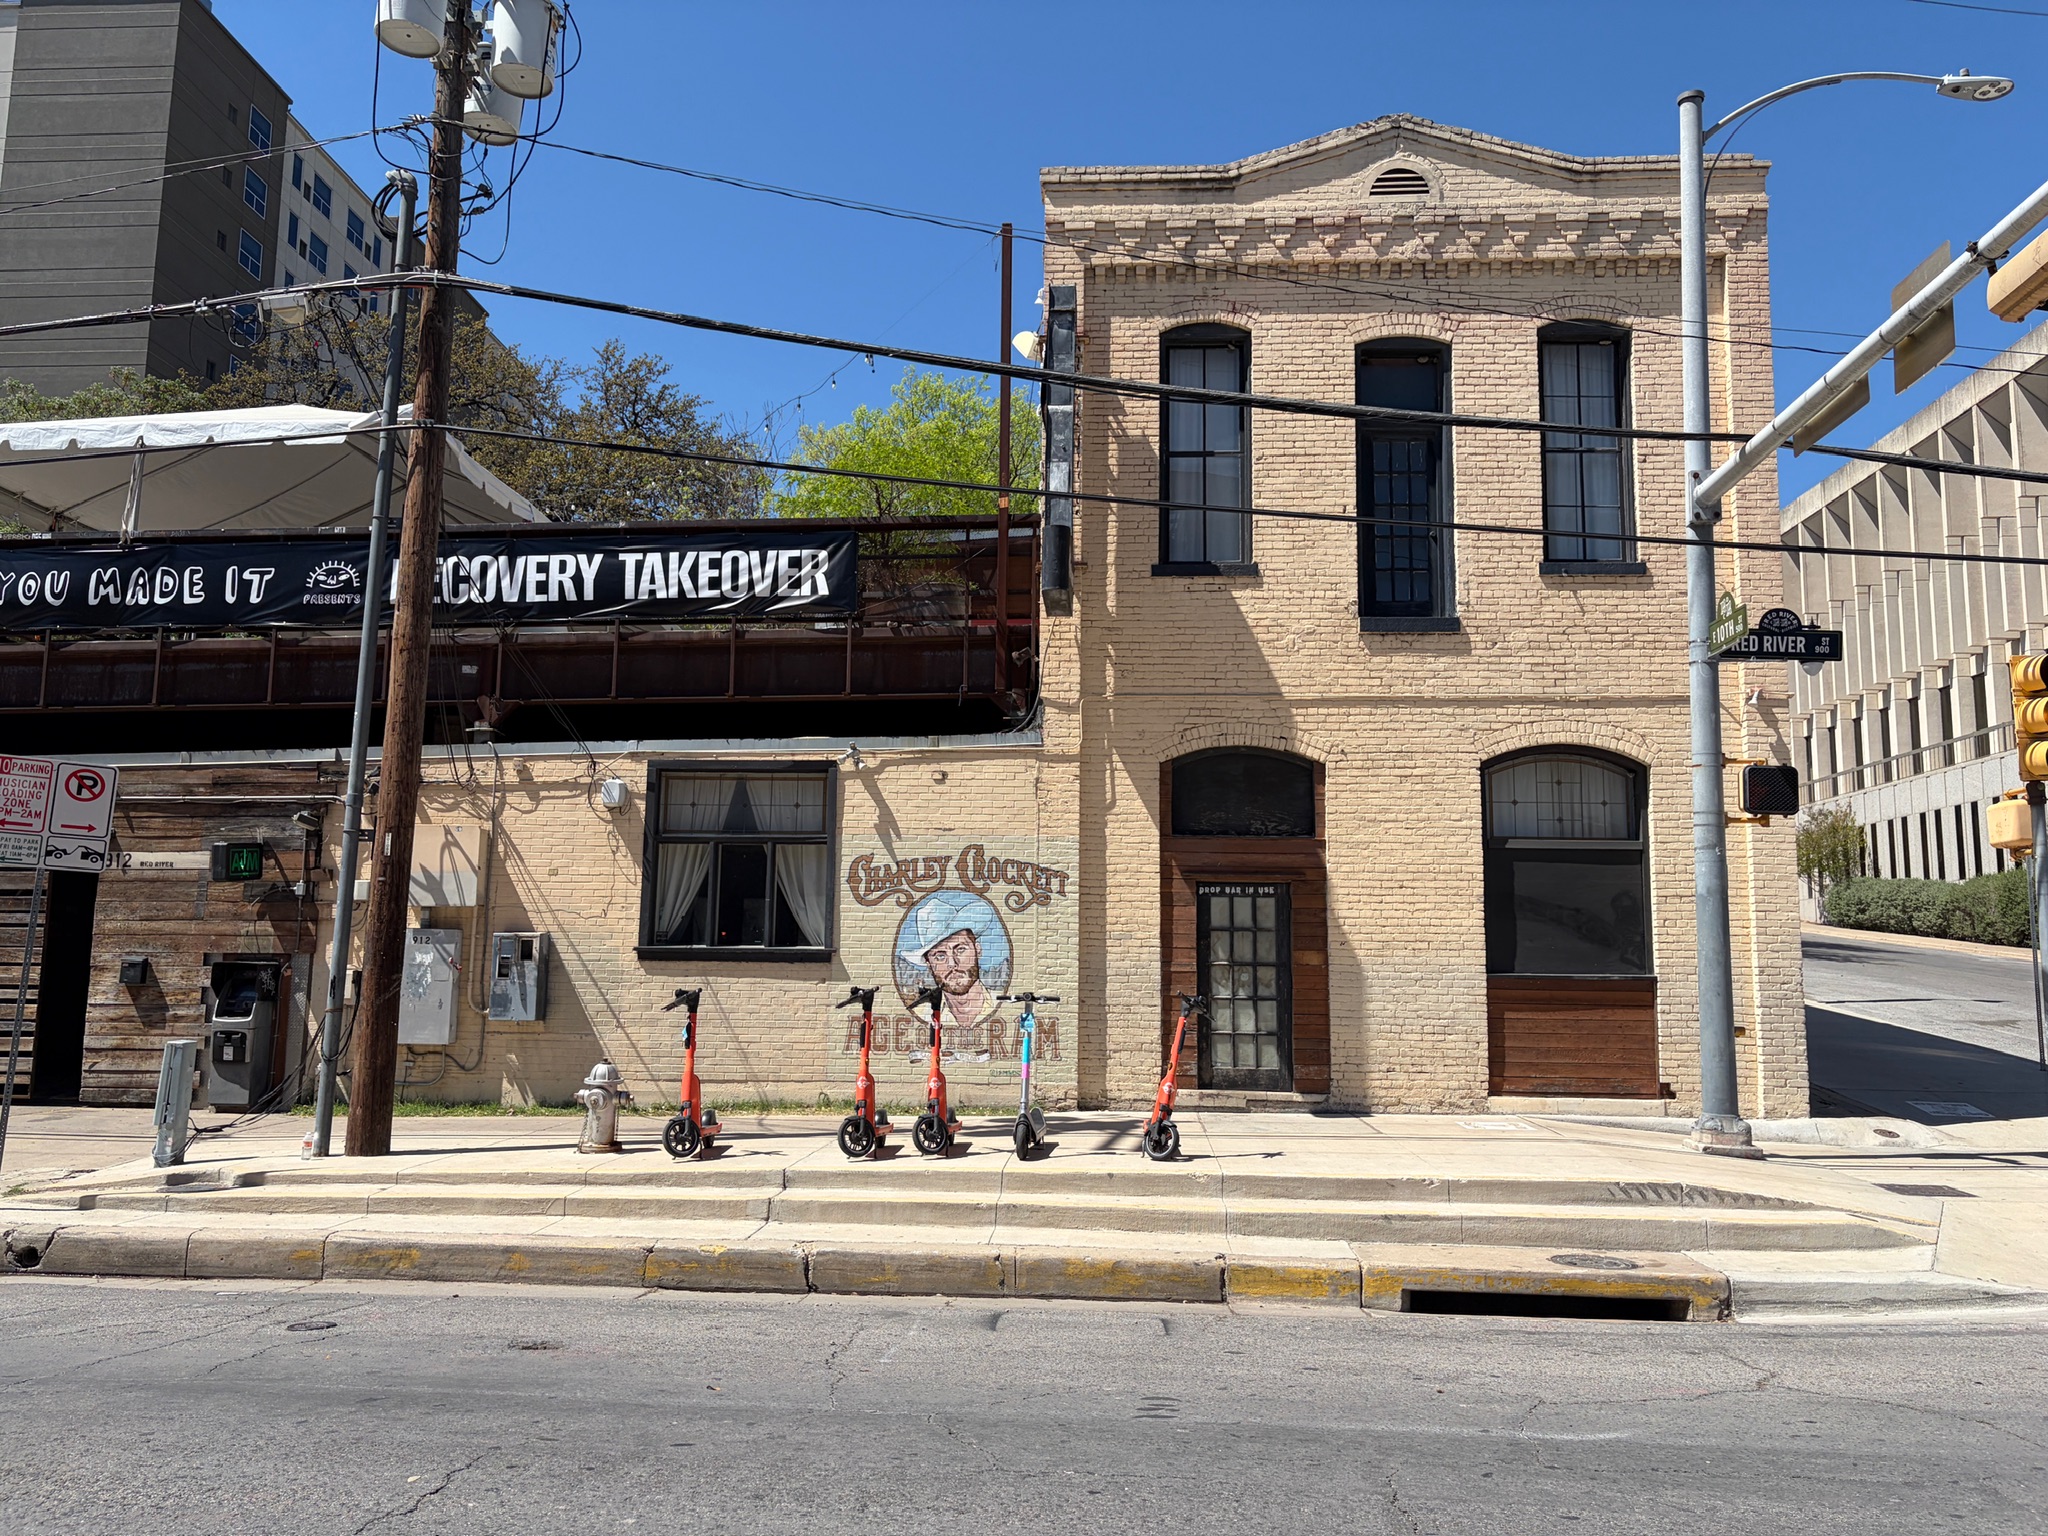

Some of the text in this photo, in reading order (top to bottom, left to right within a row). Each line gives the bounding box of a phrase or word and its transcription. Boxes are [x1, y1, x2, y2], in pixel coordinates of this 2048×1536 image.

[619, 549, 830, 599] TAKEOVER
[0, 566, 275, 606] YOU MADE IT
[303, 594, 360, 604] PRESENTS
[1763, 611, 1798, 624] RED RIVER
[1712, 631, 1716, 644] E
[1717, 619, 1734, 644] 10TH
[1763, 636, 1805, 653] RIVER
[1822, 637, 1830, 645] ST
[0, 758, 50, 775] O PARKING
[0, 788, 42, 800] OADING
[3, 798, 31, 808] ZONE
[846, 844, 1070, 913] CHARLEY CROCKETT
[1199, 886, 1220, 894] DROP
[1246, 886, 1254, 894] IN
[1258, 886, 1274, 896] USE
[412, 936, 430, 944] 912
[843, 1014, 915, 1056] AGE
